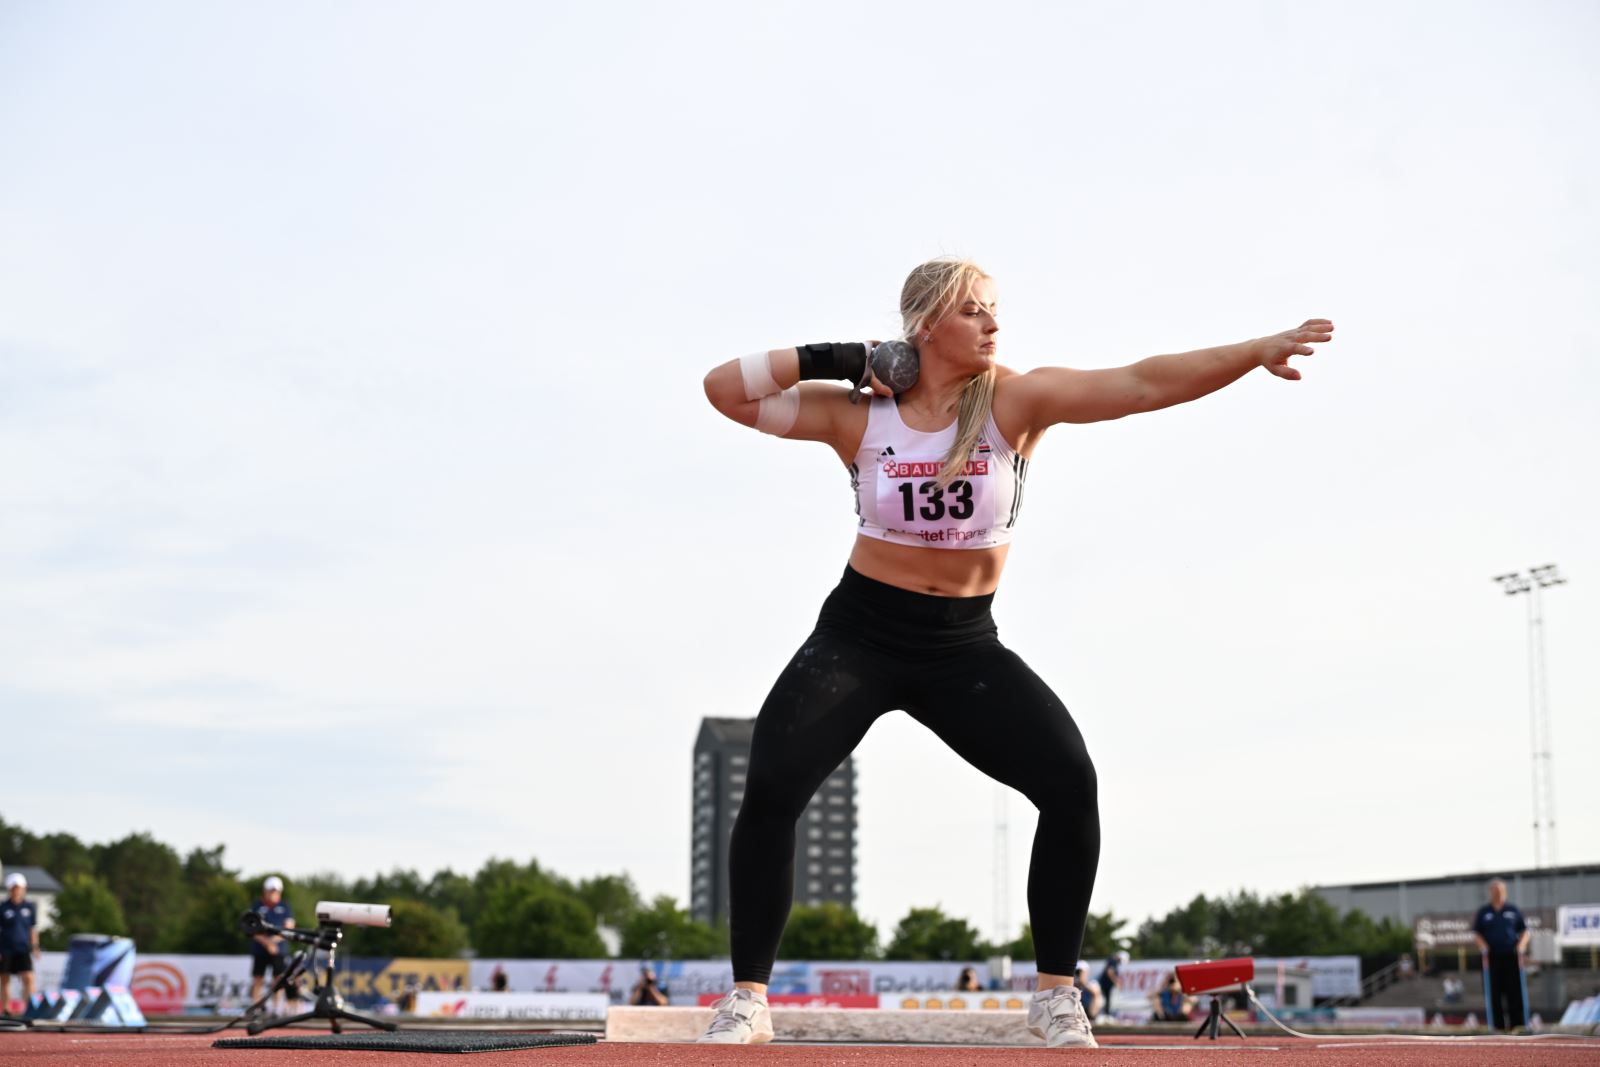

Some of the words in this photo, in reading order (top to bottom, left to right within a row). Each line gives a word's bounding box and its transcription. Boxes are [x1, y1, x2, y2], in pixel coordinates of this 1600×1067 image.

[899, 461, 987, 476] BAUUS
[898, 480, 974, 522] 133
[947, 528, 987, 541] Finans
